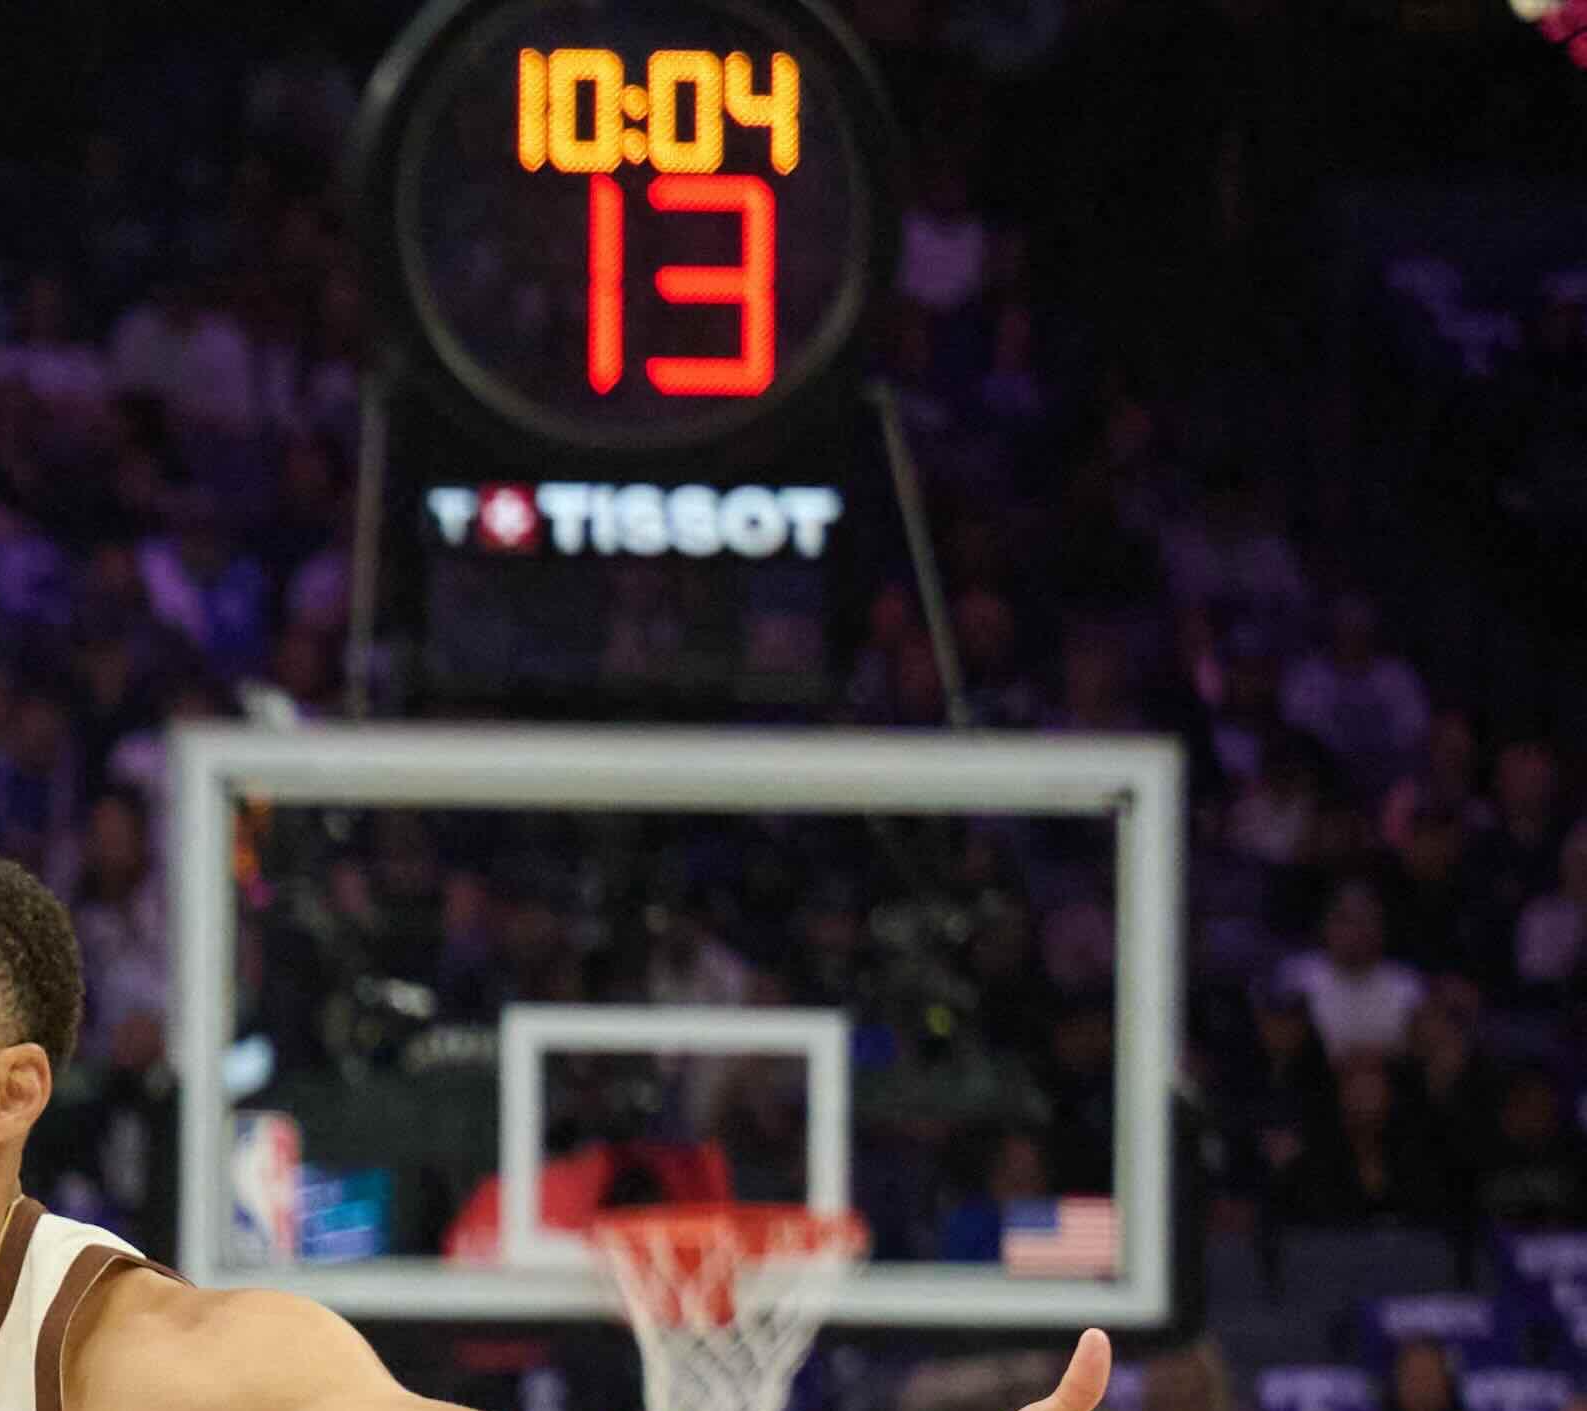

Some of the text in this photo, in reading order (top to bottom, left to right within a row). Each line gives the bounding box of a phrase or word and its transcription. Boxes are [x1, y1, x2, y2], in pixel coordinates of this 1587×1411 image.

[518, 47, 800, 175] 10:04
[586, 173, 777, 397] 13
[536, 481, 844, 559] TISSOT
